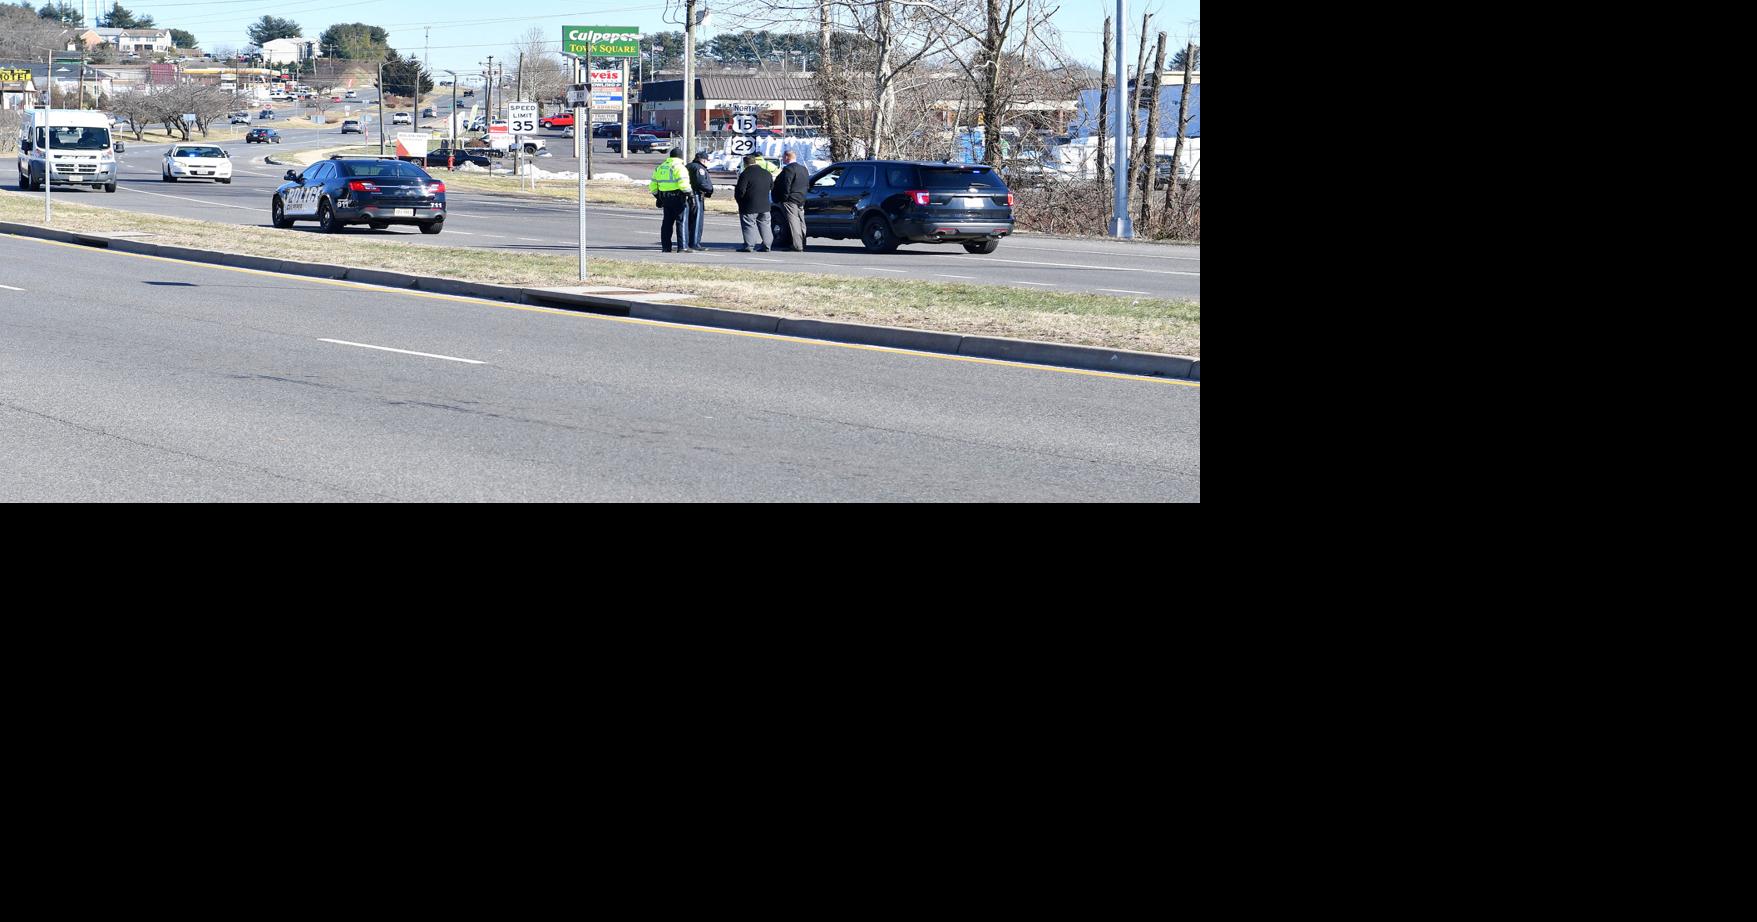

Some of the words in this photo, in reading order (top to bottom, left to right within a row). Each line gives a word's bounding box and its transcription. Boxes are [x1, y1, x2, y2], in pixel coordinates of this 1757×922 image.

[569, 30, 639, 43] Culpeper
[600, 45, 636, 53] SQUARE
[513, 121, 533, 131] 35
[738, 119, 752, 130] 15
[735, 140, 753, 150] 29
[287, 187, 323, 203] POLICE
